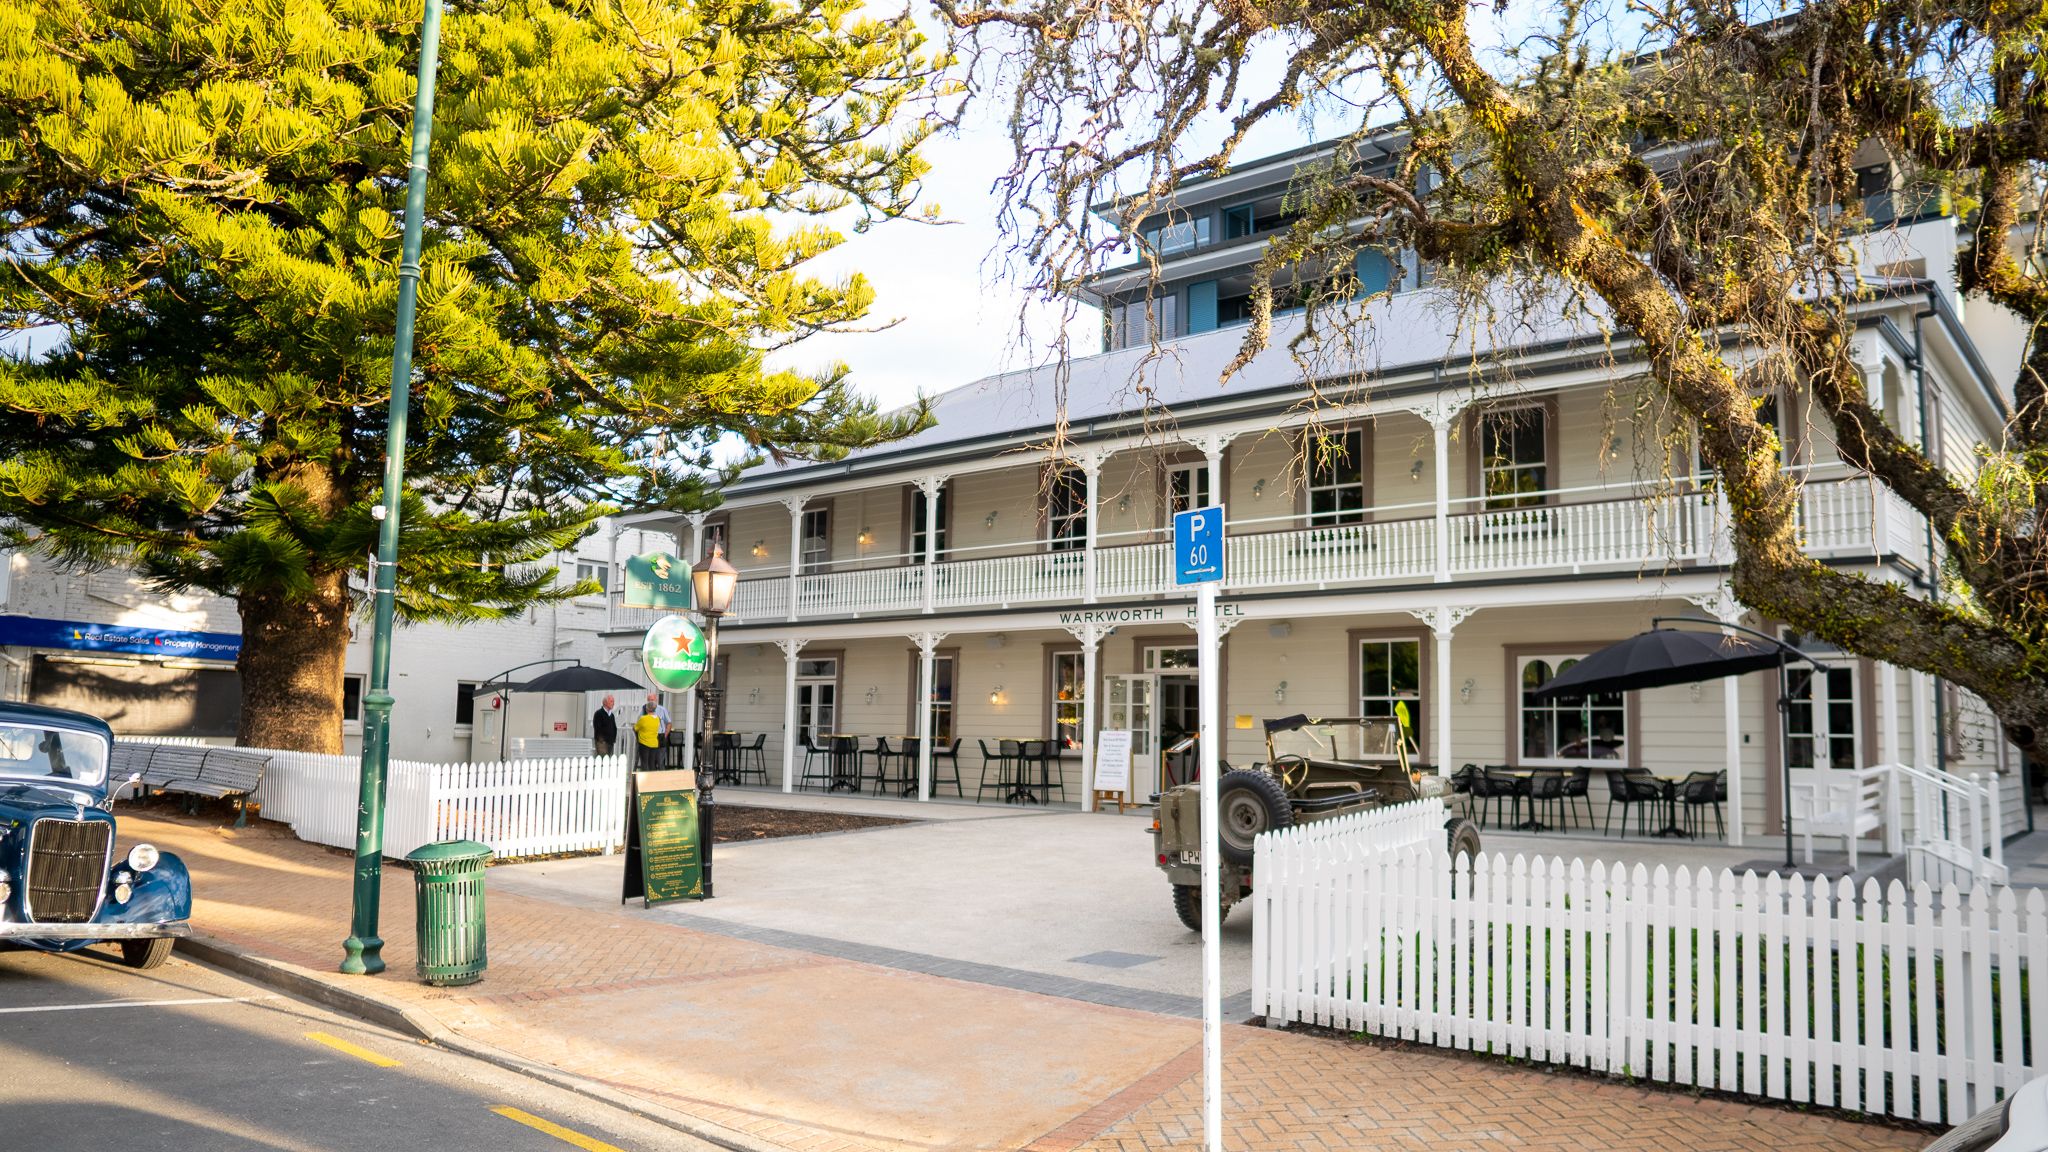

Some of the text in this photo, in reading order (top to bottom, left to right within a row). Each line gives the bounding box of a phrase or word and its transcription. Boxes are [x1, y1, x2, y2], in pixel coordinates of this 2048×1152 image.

[1190, 514, 1206, 542] P
[1190, 544, 1207, 566] 60
[658, 582, 682, 592] 1862
[1059, 604, 1245, 624] WARKWORTH HTEL
[84, 632, 150, 645] Real Estate Sales
[164, 638, 241, 652] Property Management
[652, 656, 705, 672] Heineken
